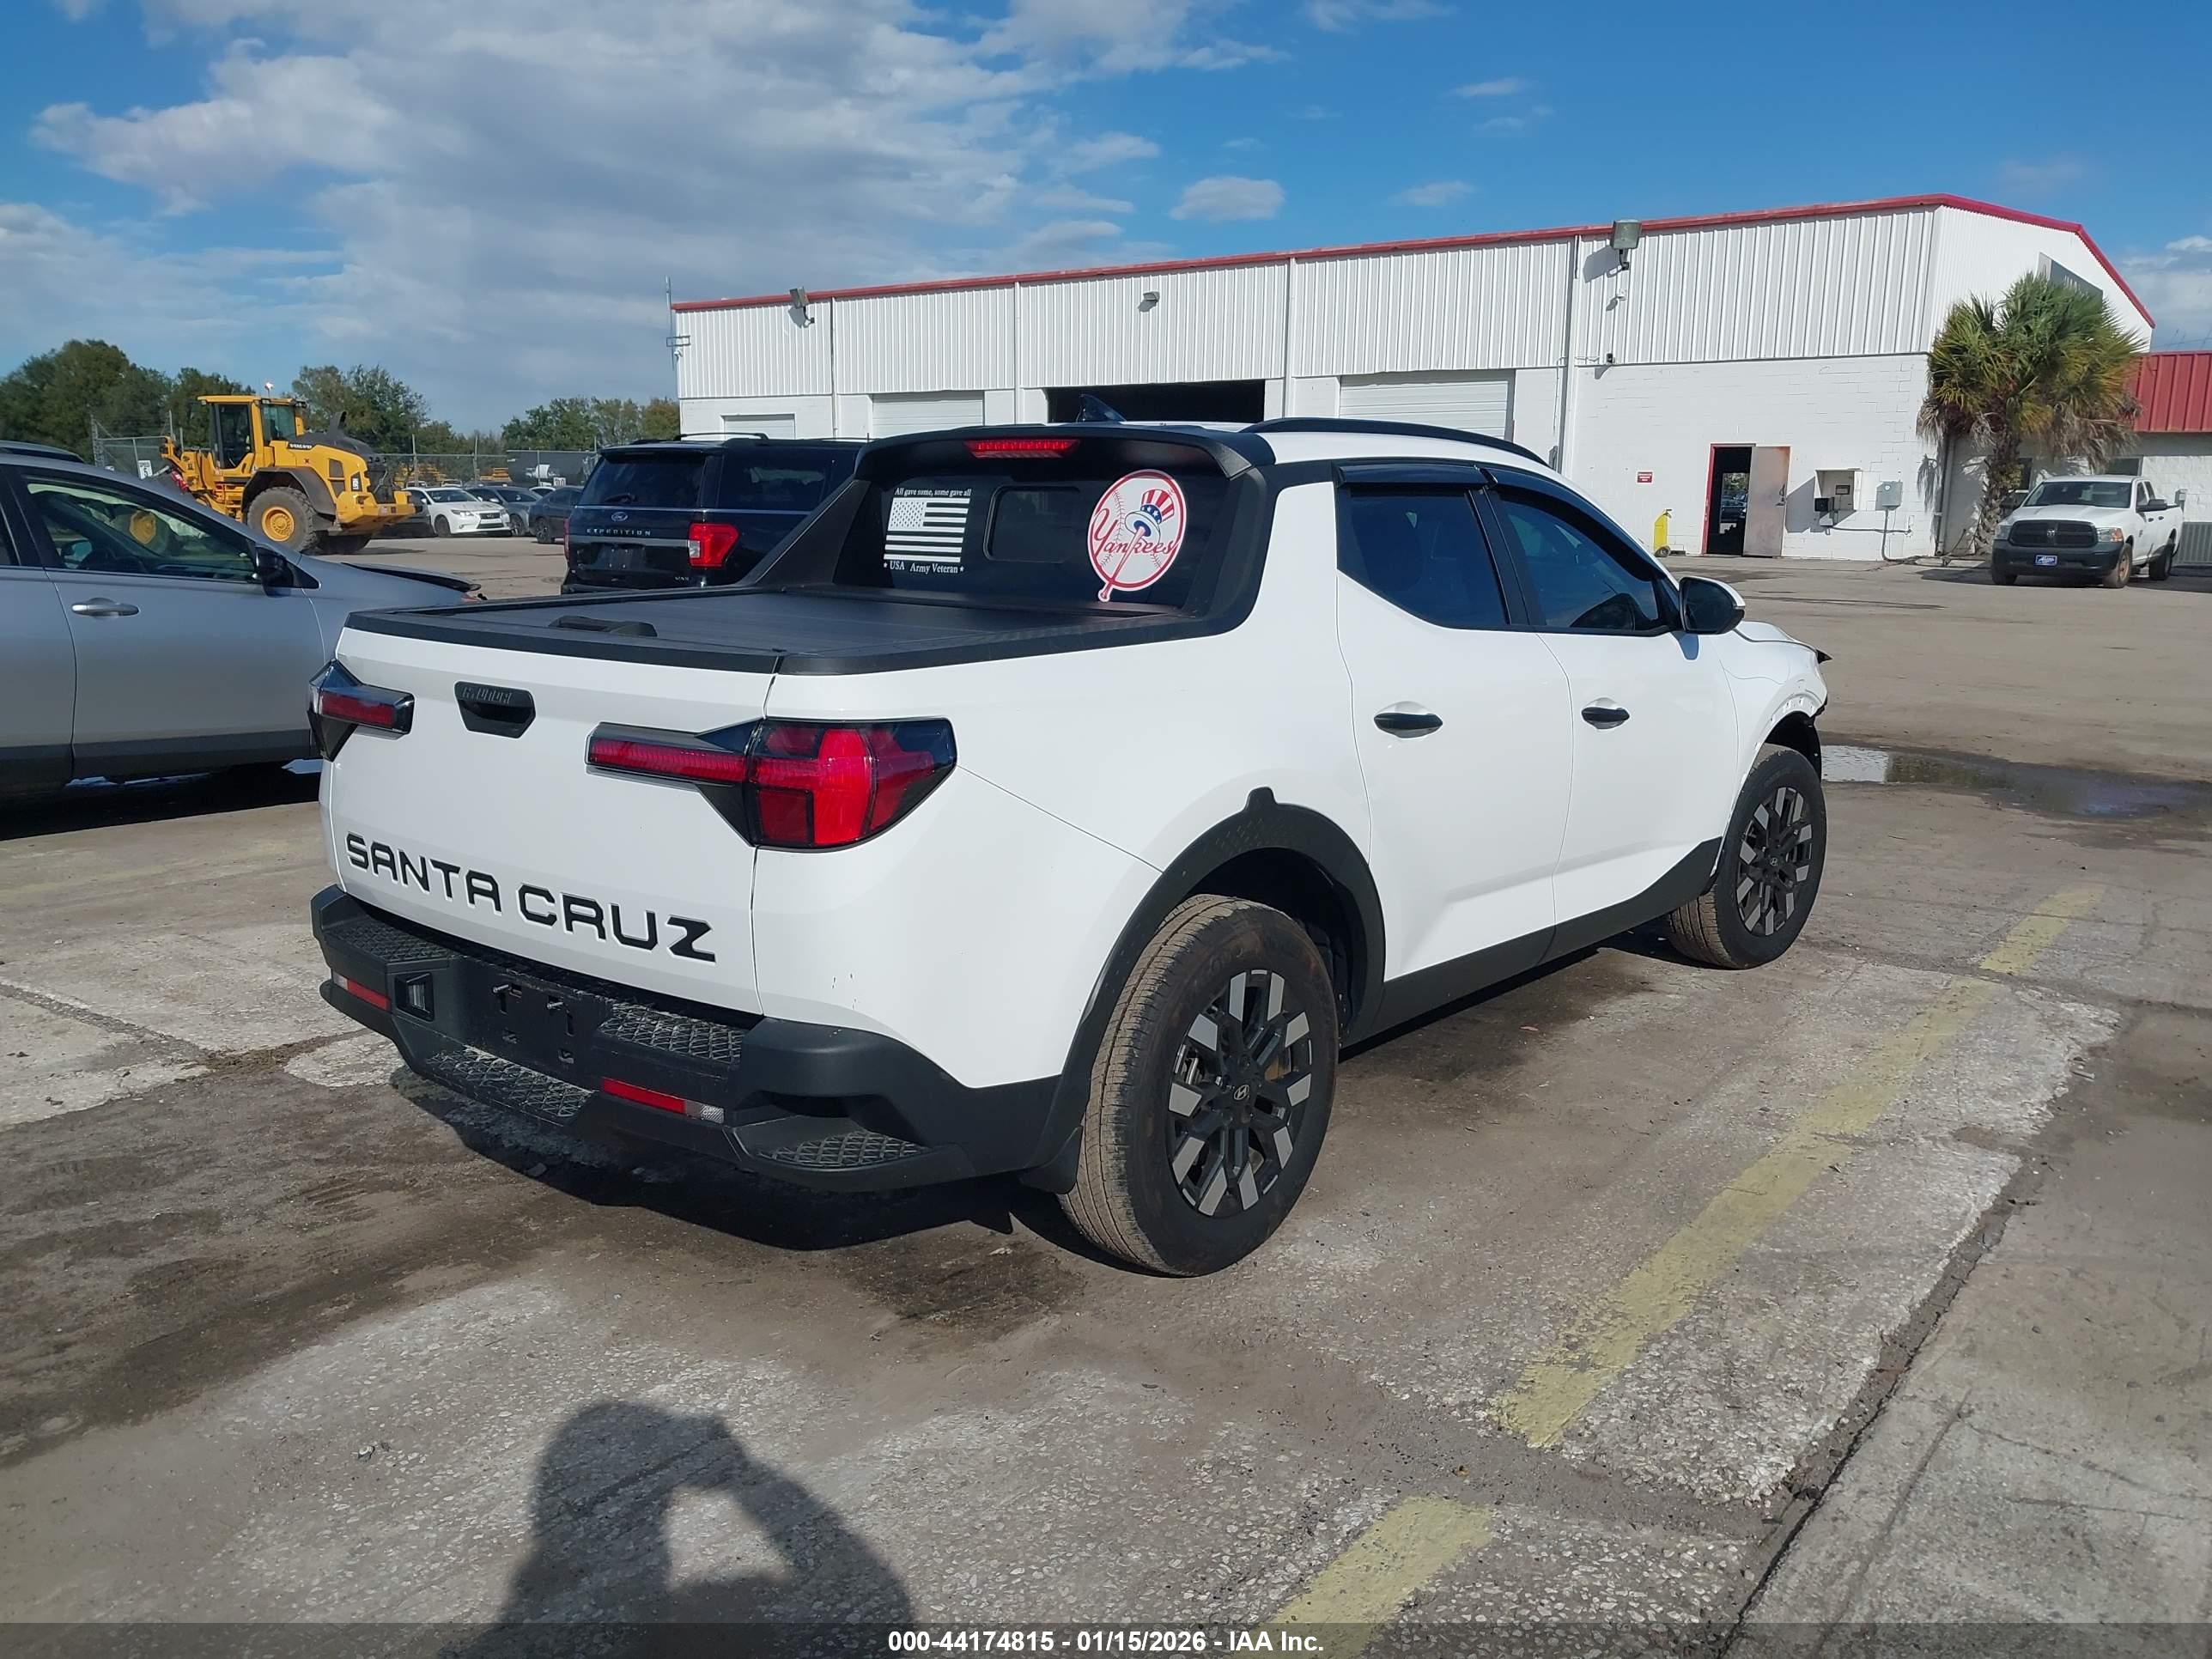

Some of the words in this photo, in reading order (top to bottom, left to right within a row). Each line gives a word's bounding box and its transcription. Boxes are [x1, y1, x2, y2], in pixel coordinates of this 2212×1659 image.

[1093, 508, 1176, 558] Yankees
[890, 561, 905, 570] USA
[909, 562, 931, 574] Army
[932, 562, 958, 574] Veteran
[345, 831, 502, 915] SANTA
[517, 882, 718, 963] CRUZ
